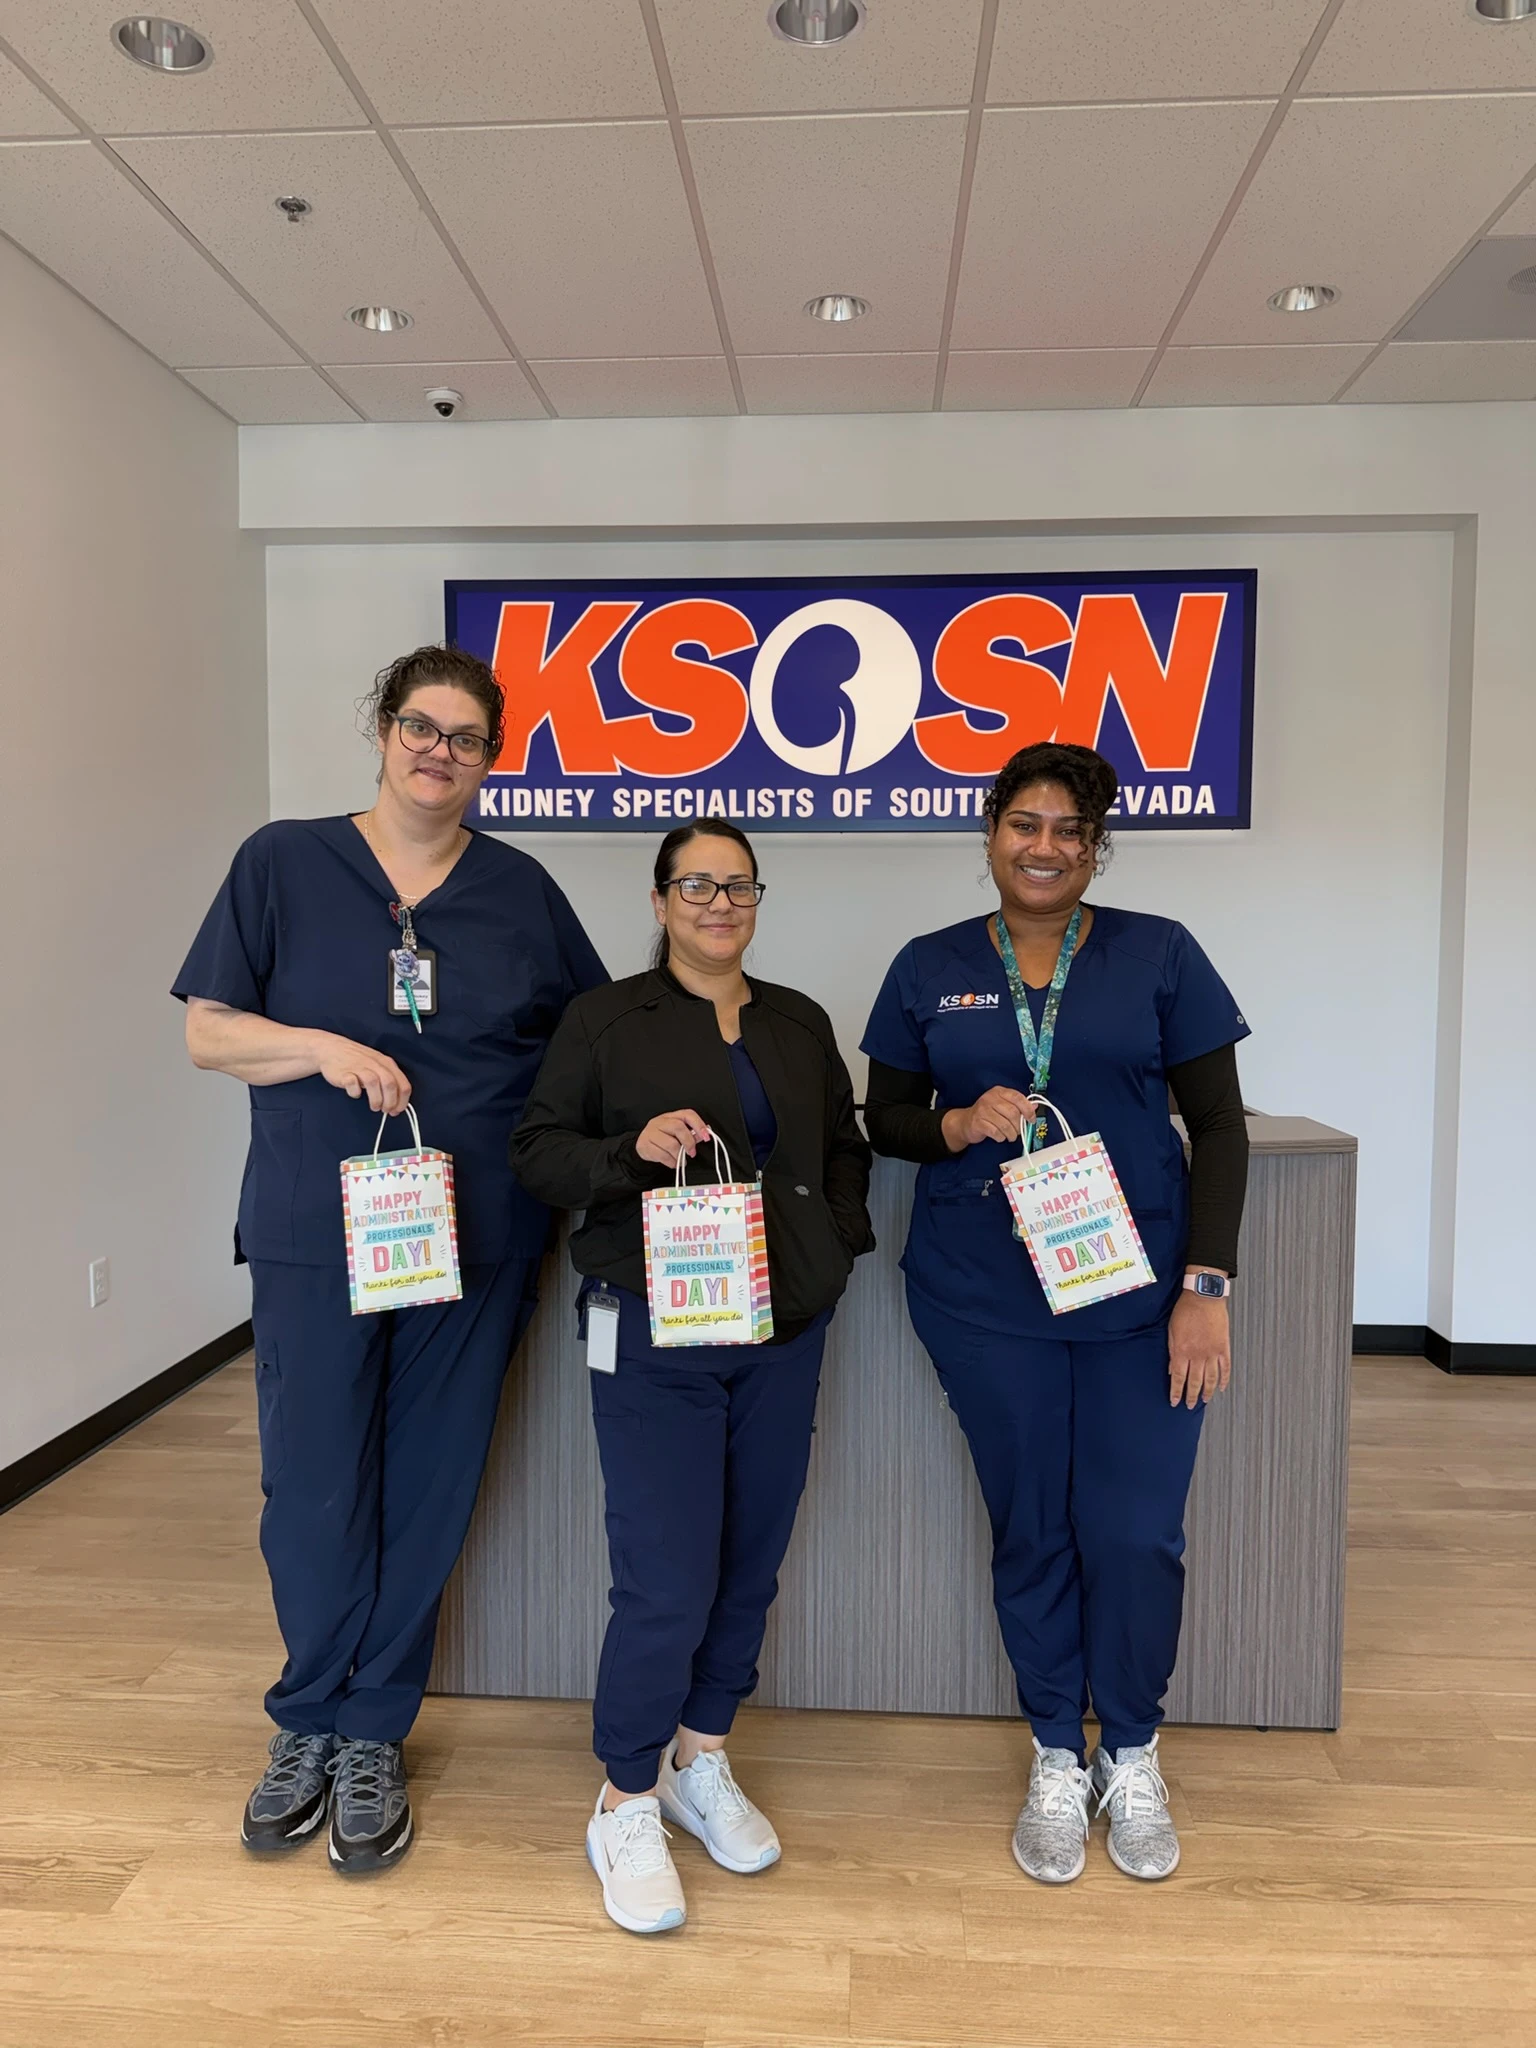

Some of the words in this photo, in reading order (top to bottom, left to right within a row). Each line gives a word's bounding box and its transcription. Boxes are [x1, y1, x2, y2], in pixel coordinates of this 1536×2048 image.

[488, 592, 1229, 777] KSOSN
[479, 788, 595, 817] KIDNEY
[612, 788, 815, 818] SPECIALISTS
[832, 788, 873, 817] OF
[889, 787, 995, 817] SOUTH
[1104, 784, 1217, 816] EVADA
[372, 1190, 423, 1211] HAPPY
[1041, 1186, 1090, 1216] HAPPY
[353, 1204, 446, 1228] ADMINISTRATIVE
[1028, 1195, 1120, 1235] ADMINISTRATIVE
[672, 1224, 721, 1243] HAPPY
[372, 1238, 432, 1273] DAY!
[653, 1240, 746, 1259] ADMINISTRATIVE
[1055, 1232, 1118, 1273] DAY!
[362, 1280, 388, 1290] Thanks
[389, 1277, 404, 1287] for
[405, 1275, 416, 1283] all
[417, 1274, 434, 1285] you
[1054, 1278, 1080, 1289] Thanks
[1081, 1273, 1095, 1284] for
[1095, 1269, 1107, 1278] all
[1107, 1266, 1124, 1277] you
[671, 1276, 729, 1307] DAY!
[660, 1315, 684, 1325] Thanks
[685, 1315, 698, 1325] for
[700, 1314, 712, 1323] all
[713, 1315, 730, 1325] you
